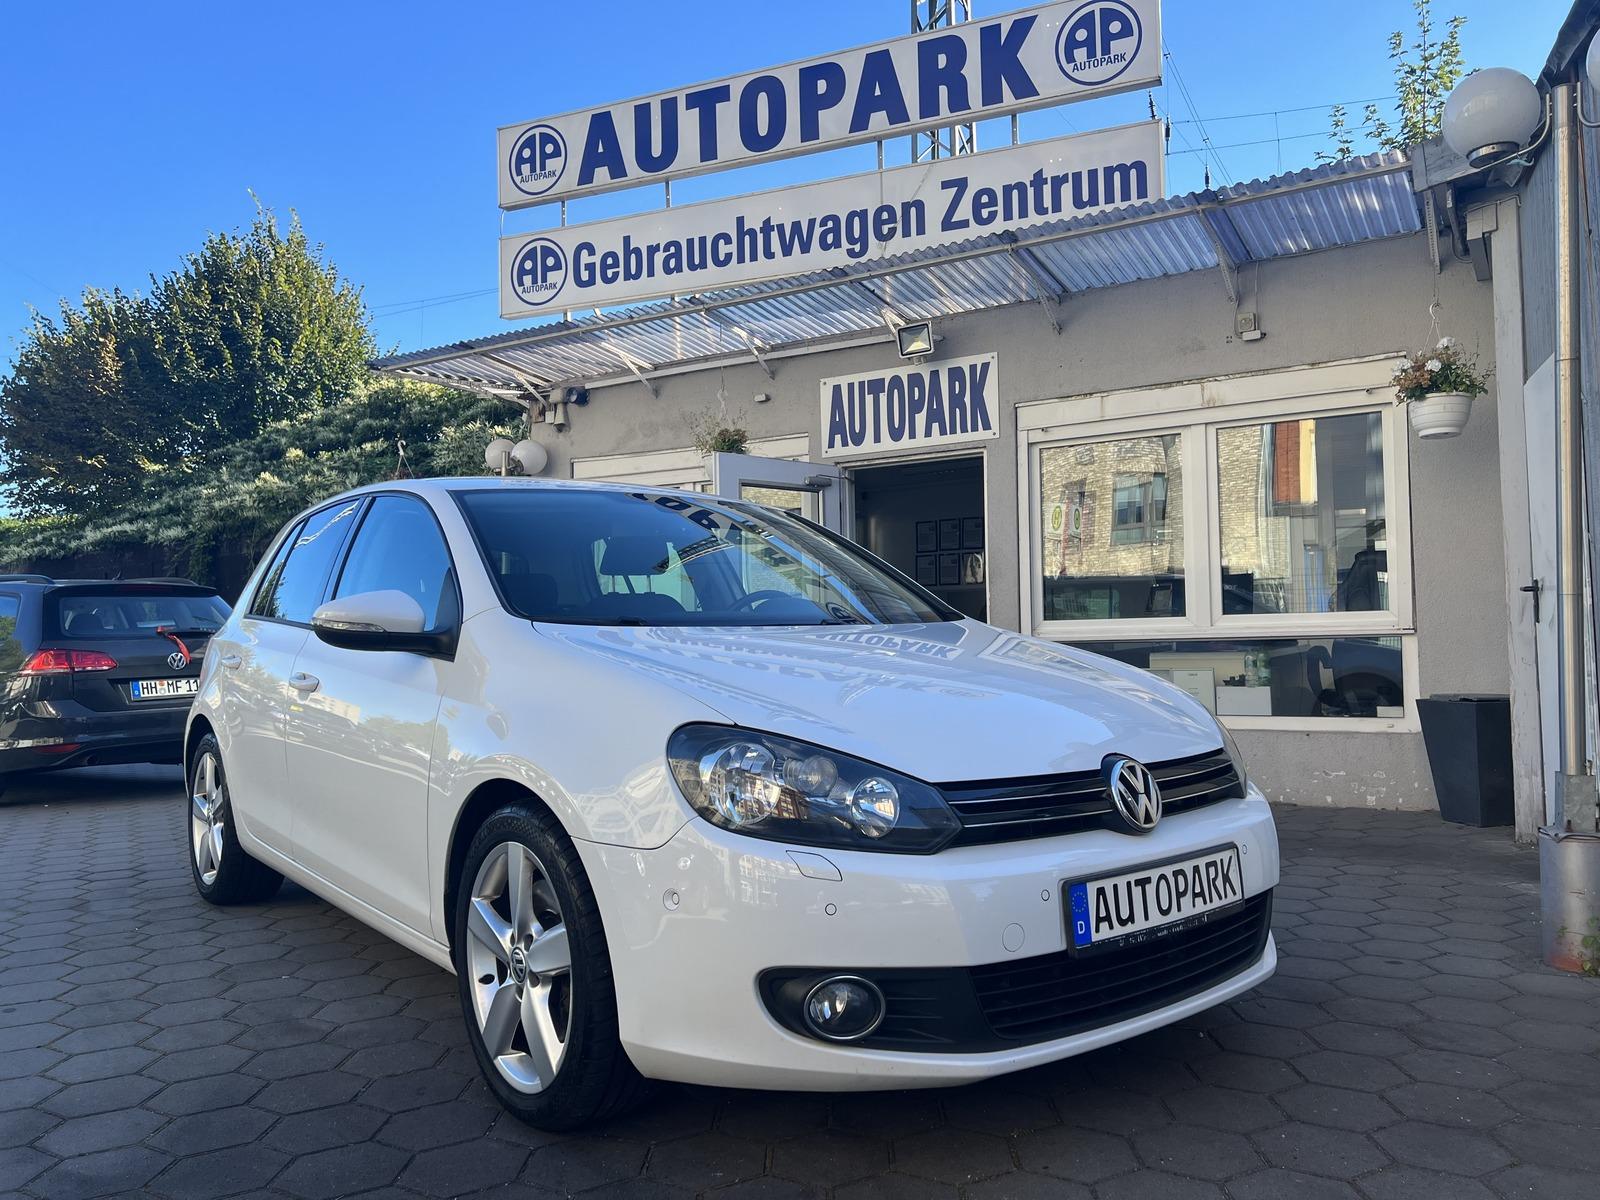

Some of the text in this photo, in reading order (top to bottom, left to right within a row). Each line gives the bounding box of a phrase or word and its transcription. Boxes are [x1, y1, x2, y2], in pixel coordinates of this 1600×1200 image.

[1064, 7, 1134, 65] AP
[1071, 52, 1127, 73] AUTOPARK
[577, 14, 1040, 187] AUTOPARK
[515, 132, 562, 177] AP
[519, 169, 557, 184] AUTOPARK
[572, 159, 1148, 289] Gebrauchtwagen Zentrum
[516, 244, 563, 288] AP
[521, 282, 558, 295] AUTOPARK
[827, 361, 992, 449] AUTOPARK
[141, 682, 158, 695] HH
[167, 680, 182, 693] MF
[1094, 855, 1237, 934] AUTOPARK
[1077, 921, 1086, 935] D
